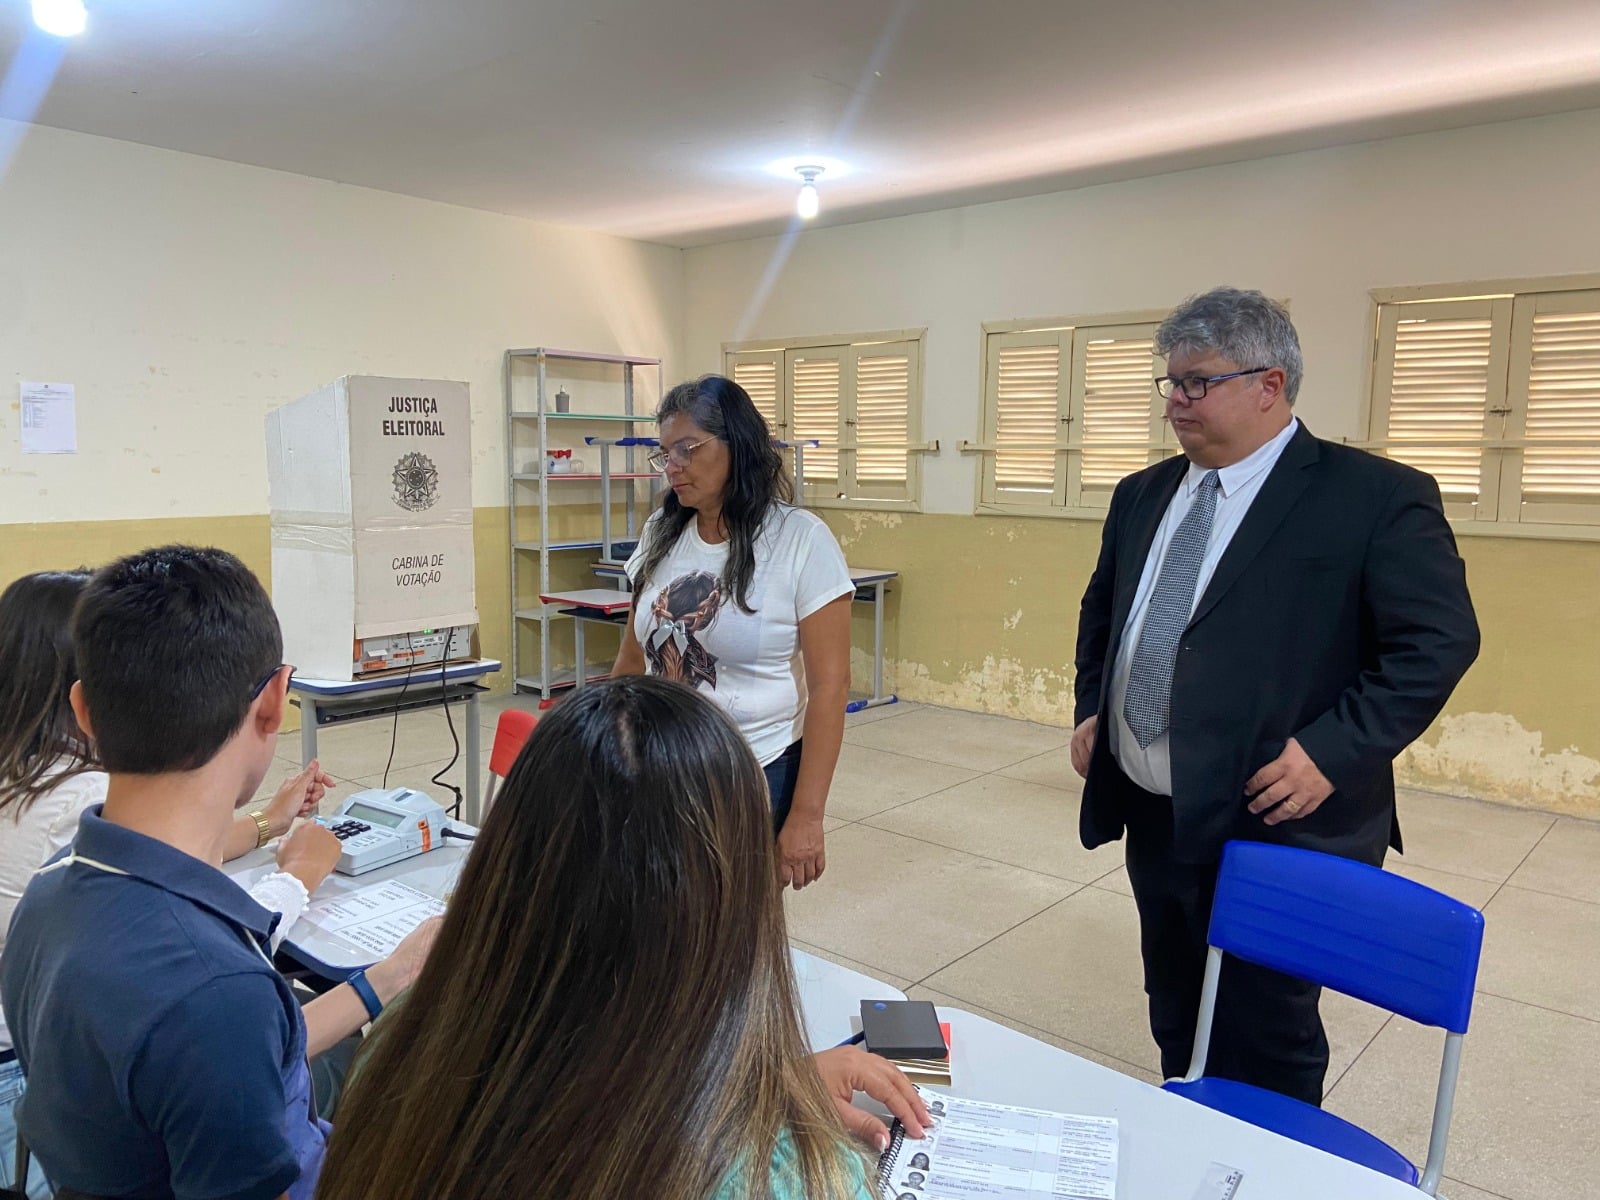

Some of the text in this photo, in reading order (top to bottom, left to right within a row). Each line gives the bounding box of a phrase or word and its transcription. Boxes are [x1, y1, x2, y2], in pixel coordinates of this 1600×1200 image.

[388, 396, 438, 417] JUSTIÇA
[382, 420, 446, 436] ELEITORAL
[392, 553, 444, 570] CABINA DE
[396, 569, 441, 587] VOTAÇÃO
